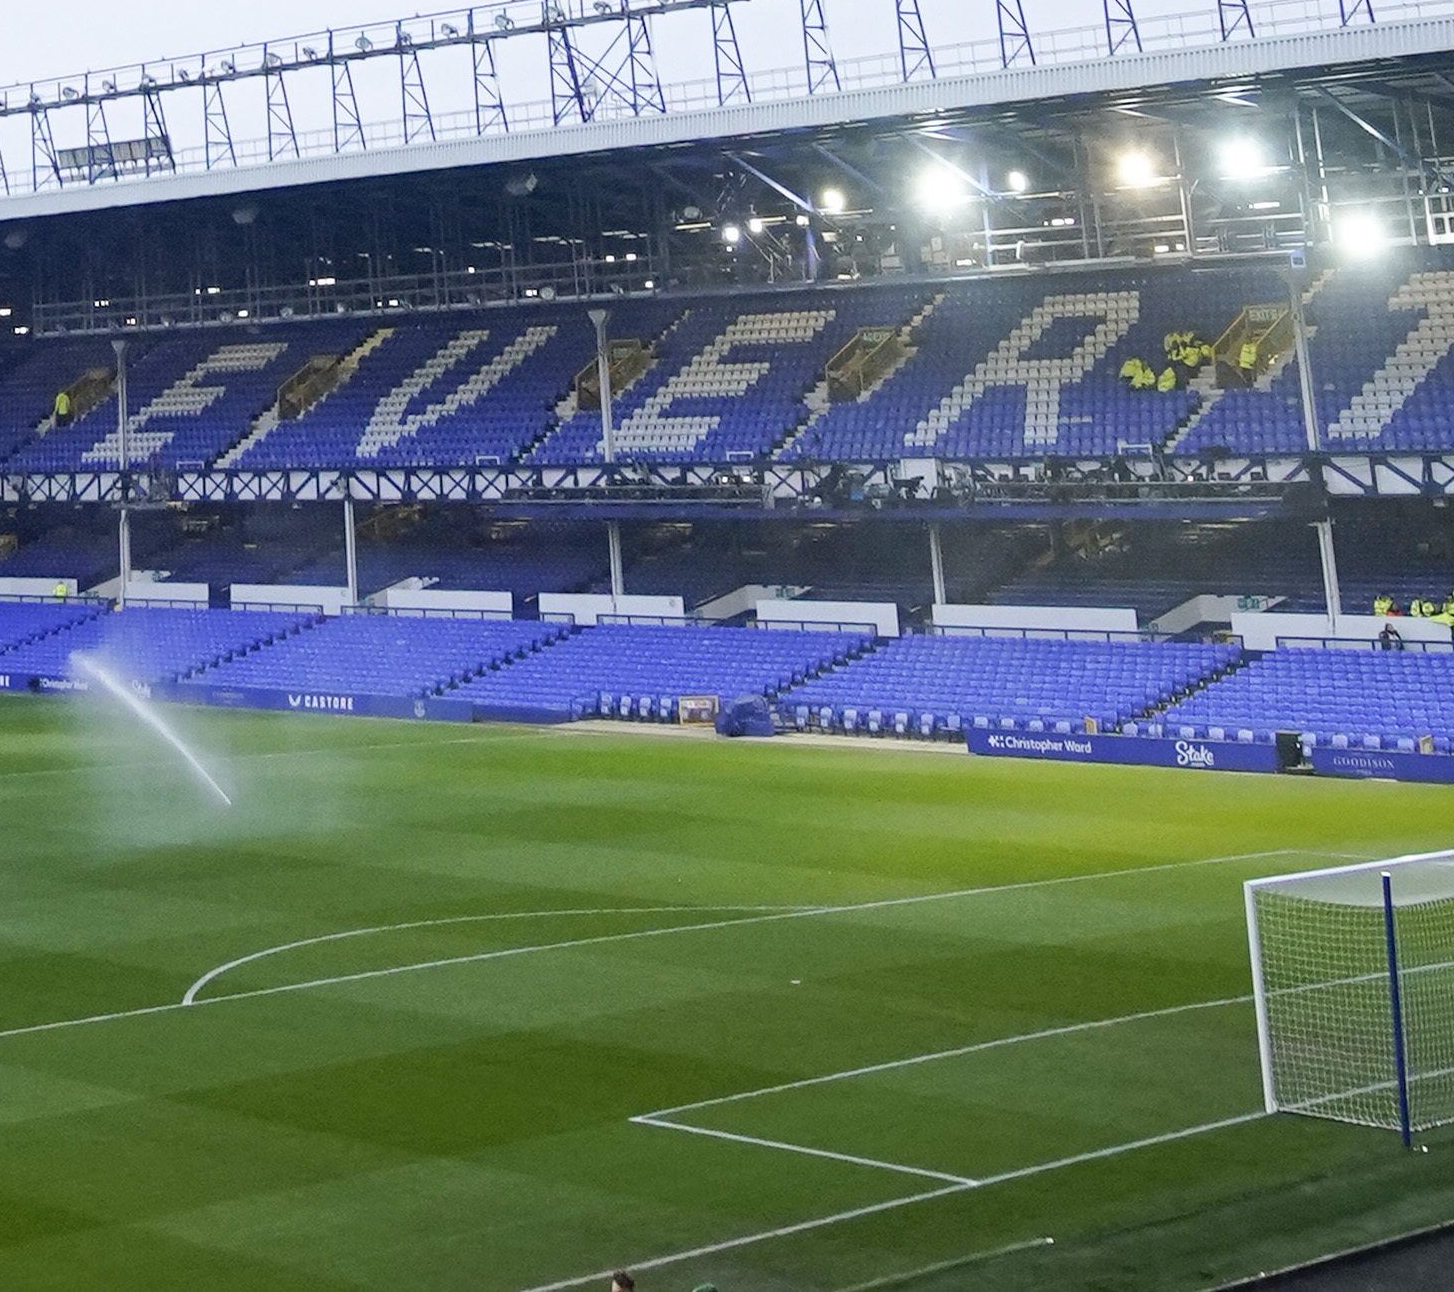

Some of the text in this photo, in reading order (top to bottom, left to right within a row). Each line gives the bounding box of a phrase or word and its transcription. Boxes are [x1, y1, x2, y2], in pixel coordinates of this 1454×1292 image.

[304, 694, 354, 711] CASTORE
[1005, 735, 1092, 754] Christopher Ward
[1175, 740, 1215, 766] Stake
[1333, 756, 1395, 769] GOODISON
